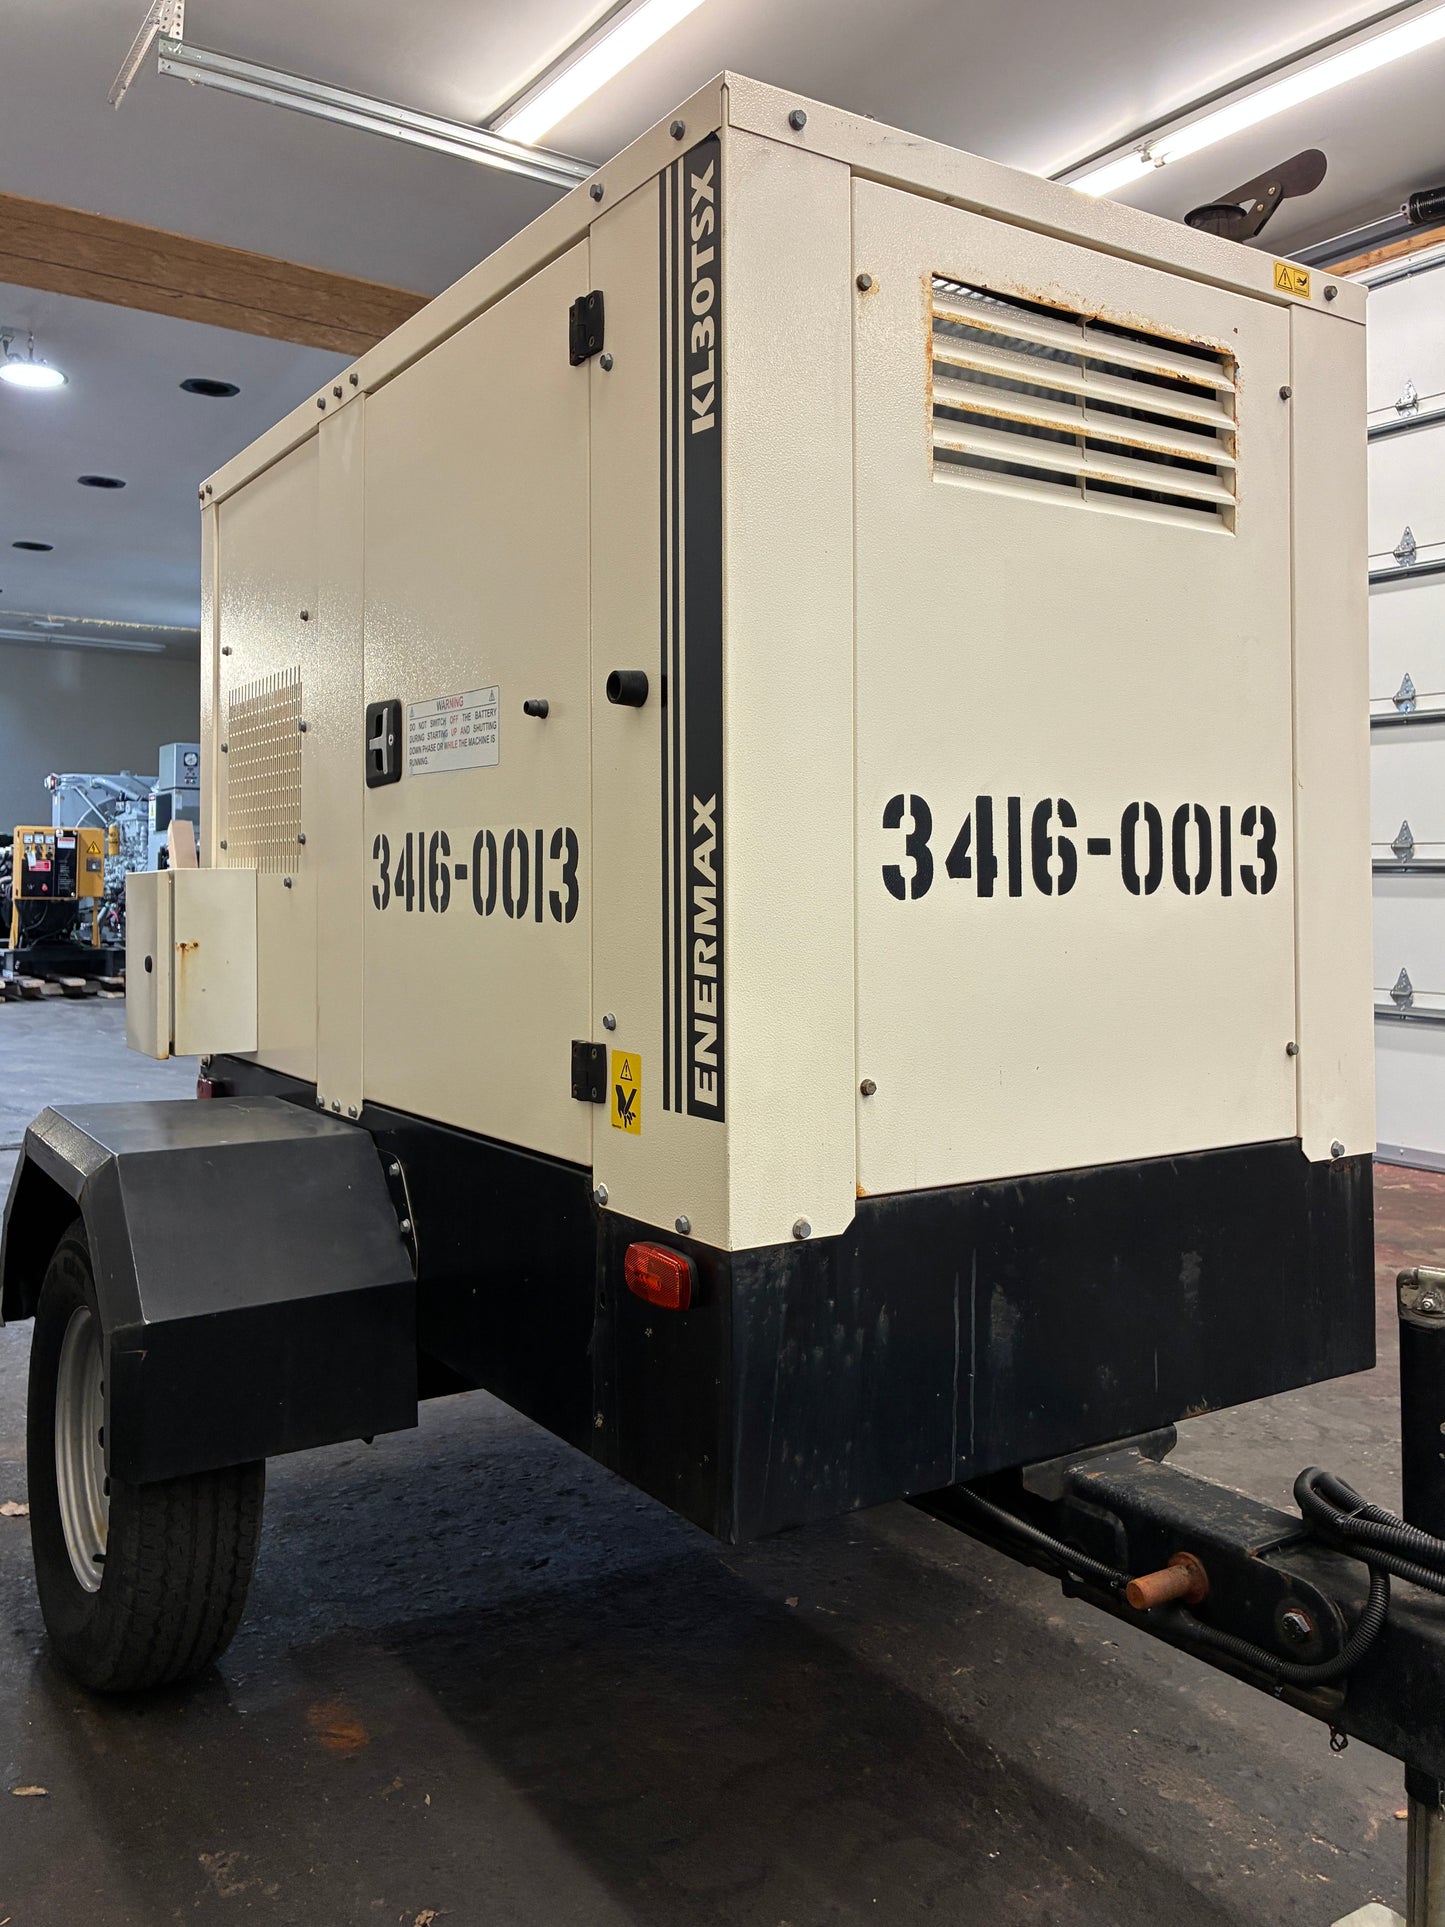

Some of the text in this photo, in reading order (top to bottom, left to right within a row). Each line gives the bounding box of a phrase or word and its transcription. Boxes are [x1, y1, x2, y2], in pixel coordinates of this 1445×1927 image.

[690, 159, 715, 435] KL30TSX
[409, 708, 497, 731] DO NOT SWITCH OFF THE BATTERY
[409, 721, 497, 743] DURING STARTING UP AND SHUTTING
[436, 696, 464, 711] WARNING
[409, 734, 496, 755] DOWN PHASE OR WHILE THE MACHINE IS
[372, 827, 579, 924] 3416-0013
[882, 793, 1278, 900] 3416-0013
[692, 793, 718, 1107] ENERMAX
